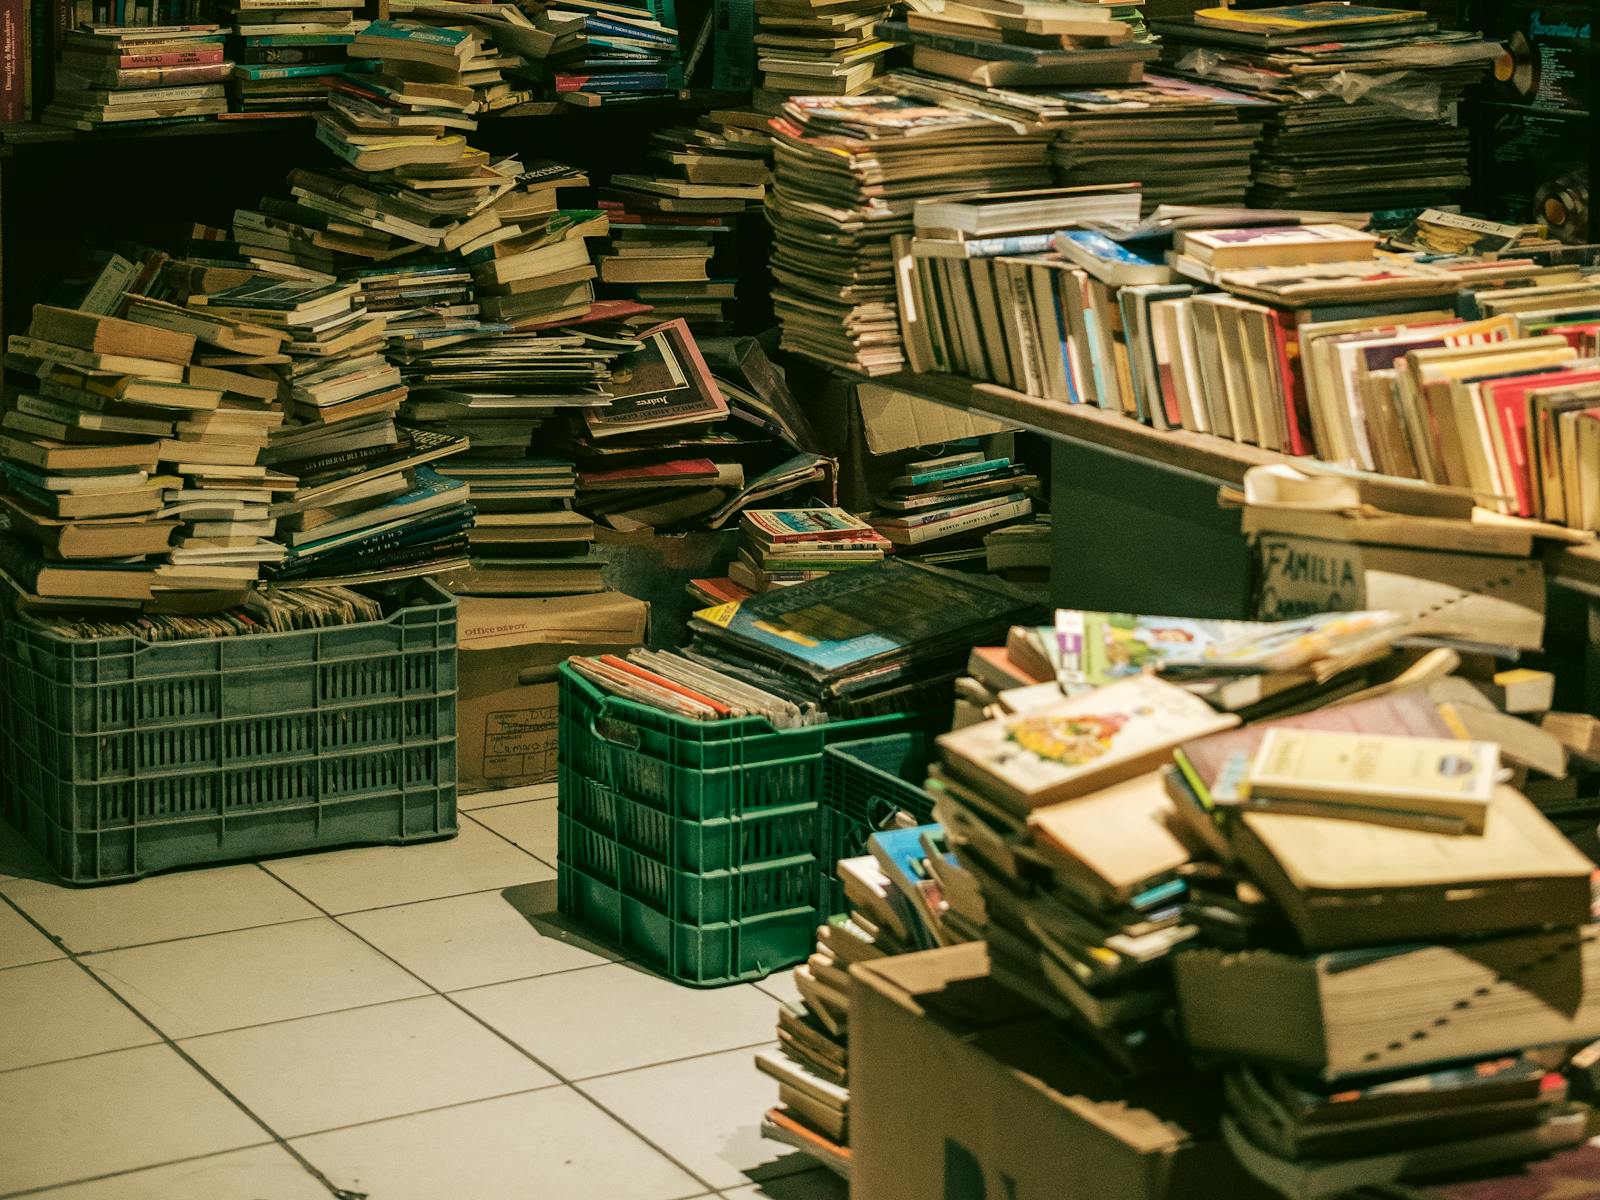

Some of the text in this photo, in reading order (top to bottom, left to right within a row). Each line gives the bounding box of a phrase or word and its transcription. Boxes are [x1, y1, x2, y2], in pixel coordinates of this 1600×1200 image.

[362, 530, 403, 546] CHINA
[358, 541, 400, 556] CHINA
[464, 626, 495, 636] Office
